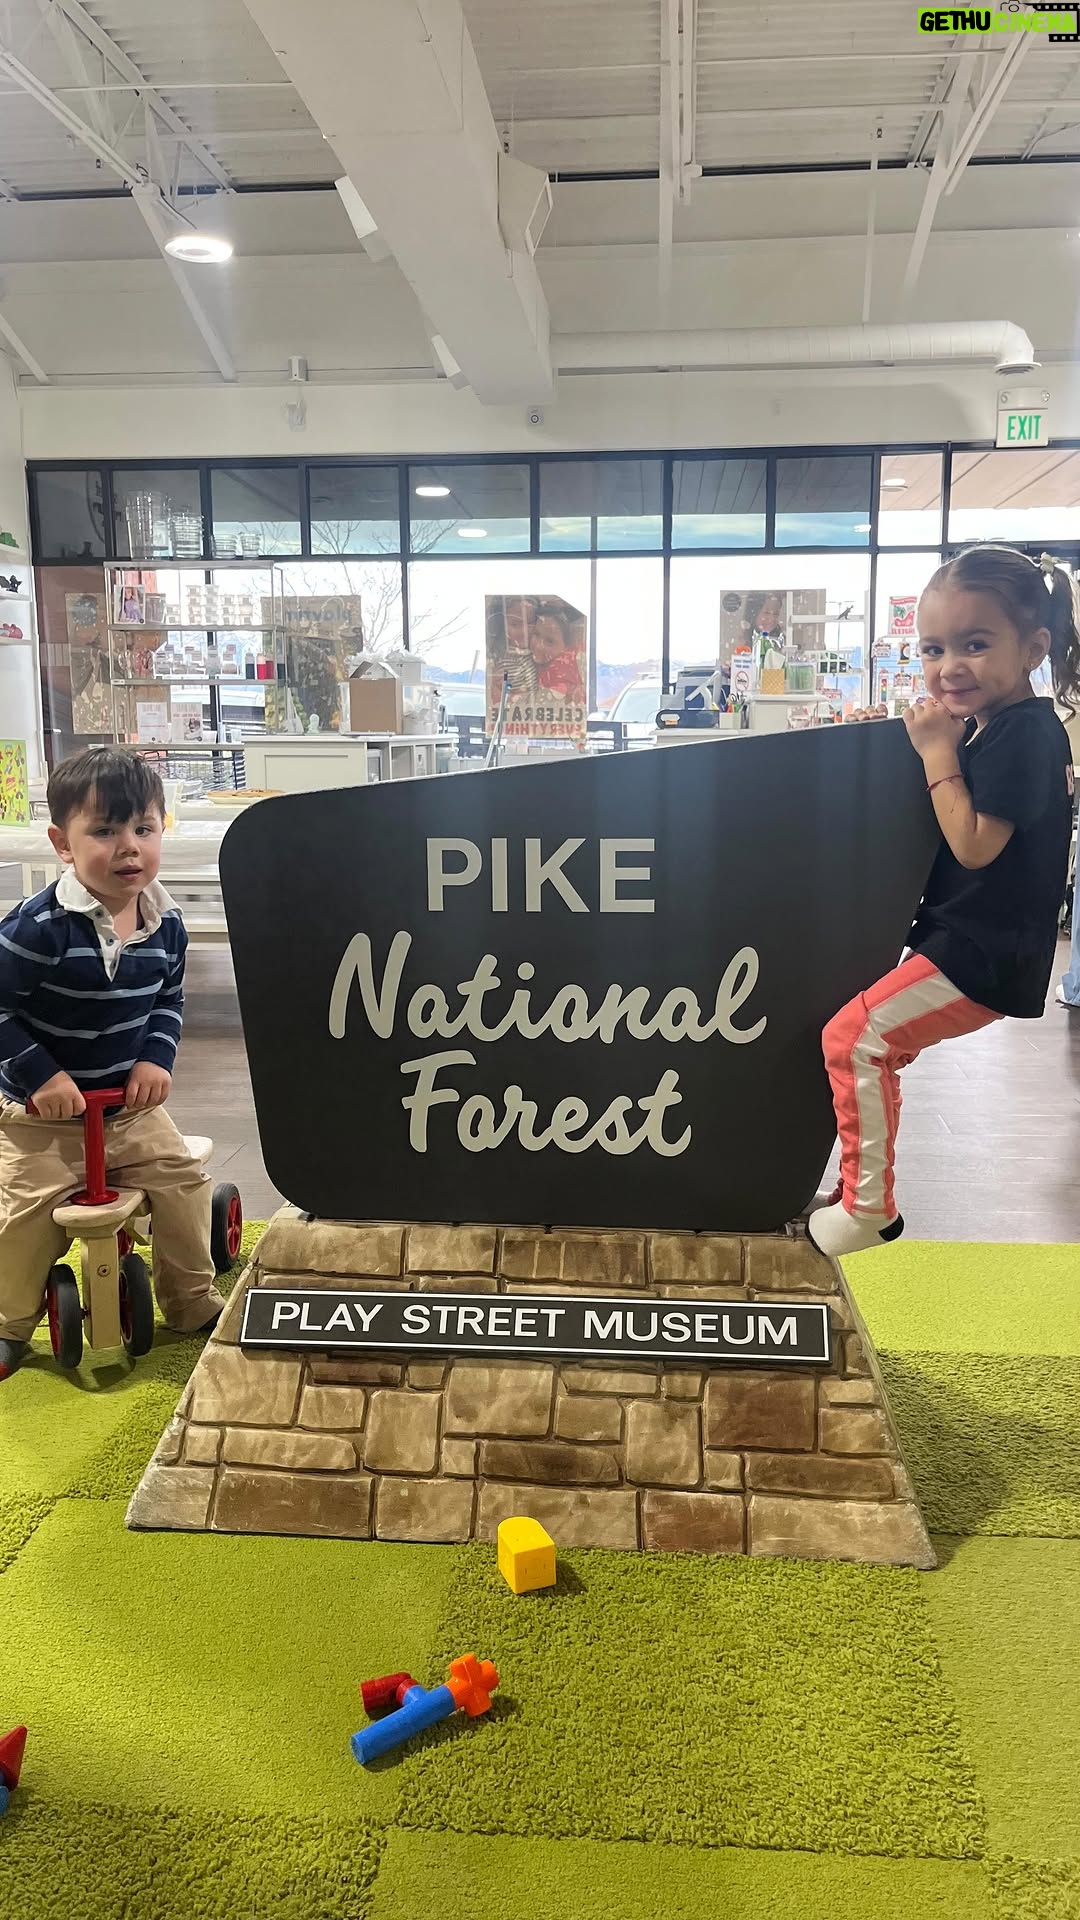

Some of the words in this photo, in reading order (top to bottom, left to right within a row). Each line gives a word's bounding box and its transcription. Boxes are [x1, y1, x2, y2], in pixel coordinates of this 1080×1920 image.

[1007, 414, 1042, 441] EXIT
[426, 837, 656, 914] PIKE
[328, 931, 768, 1044] National
[400, 1049, 692, 1157] Forest
[271, 1301, 384, 1332] PLAY
[401, 1304, 566, 1338] STREET
[583, 1310, 799, 1346] MUSEUM
